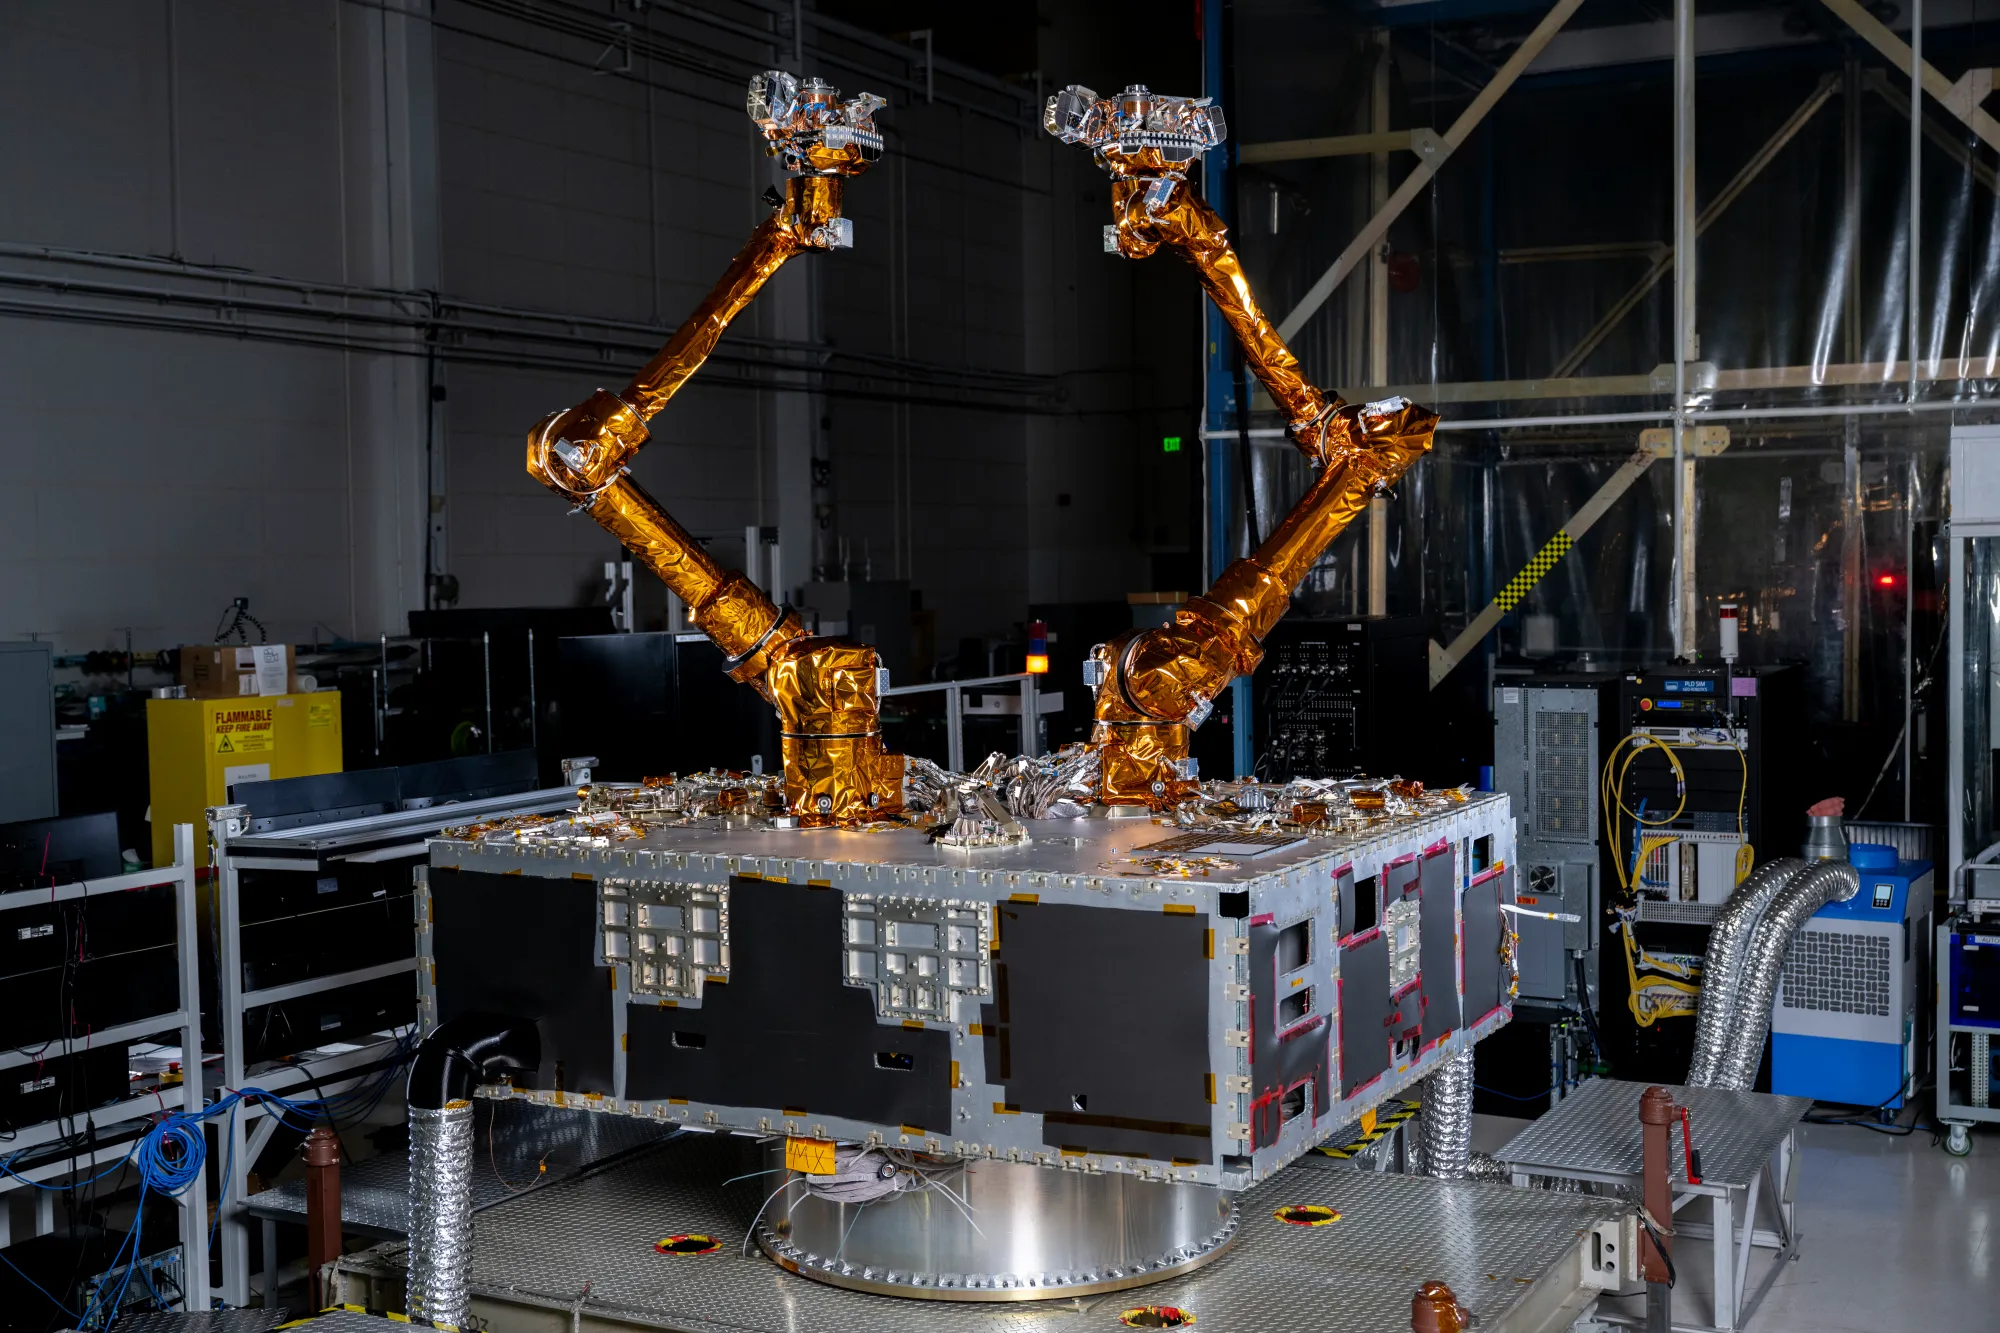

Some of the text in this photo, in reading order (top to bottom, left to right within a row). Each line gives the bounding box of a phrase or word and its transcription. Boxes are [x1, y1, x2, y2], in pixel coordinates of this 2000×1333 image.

[1163, 437, 1181, 452] EXIT
[216, 709, 272, 724] FLAMMABLE
[216, 722, 271, 733] KEEP FIRE AWAY
